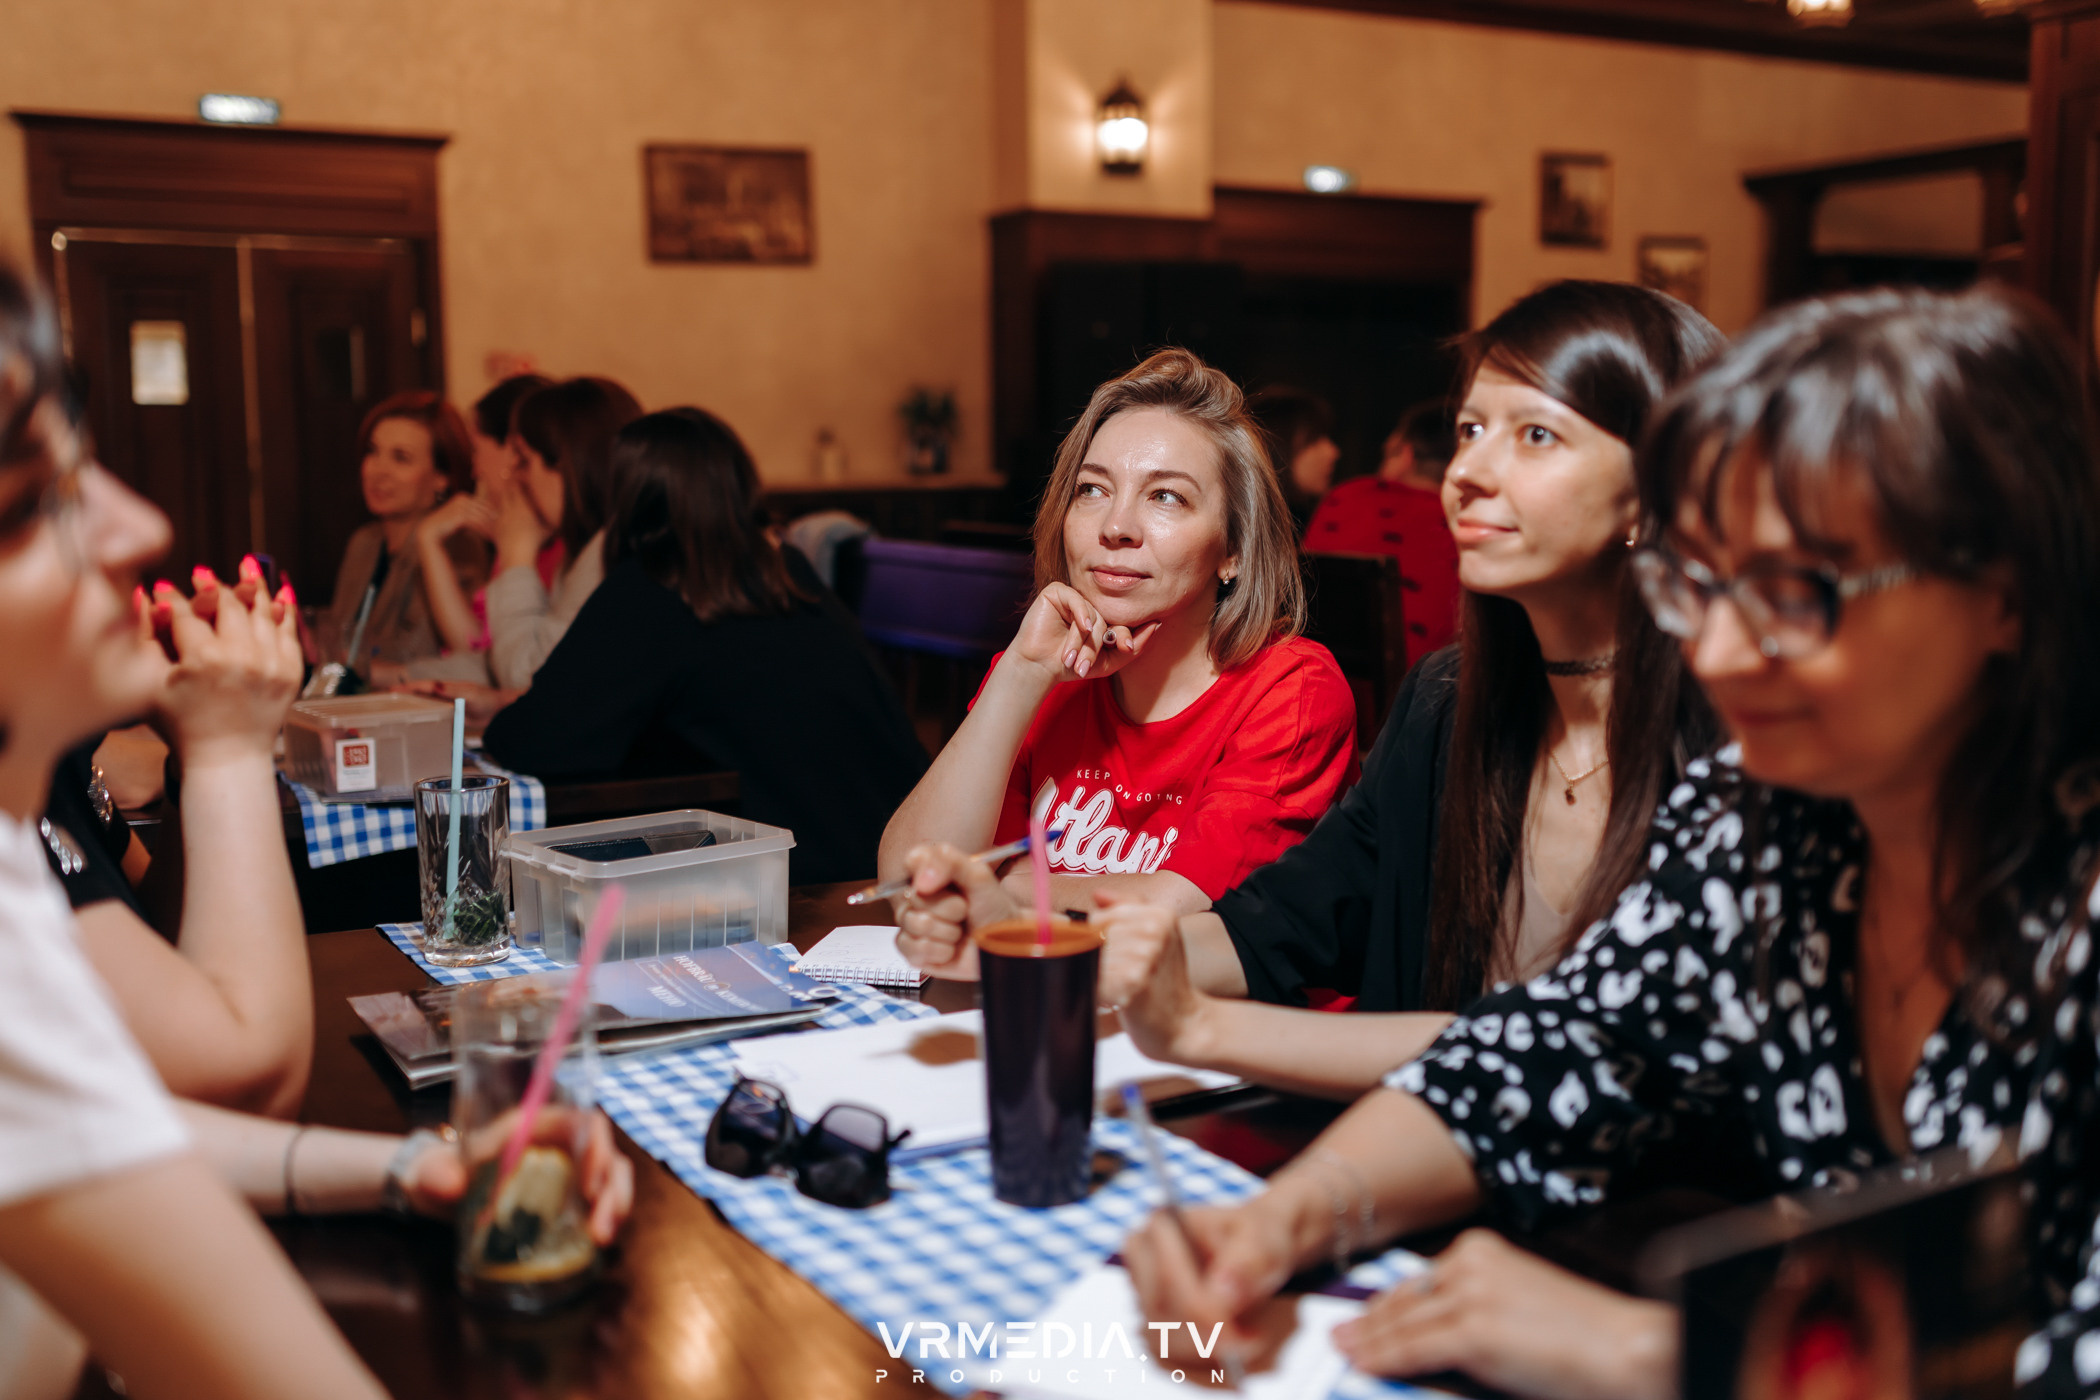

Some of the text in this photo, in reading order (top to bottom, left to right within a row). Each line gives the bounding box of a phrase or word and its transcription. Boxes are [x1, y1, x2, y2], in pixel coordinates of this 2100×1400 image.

[1076, 769, 1183, 805] KEEP ON GOING
